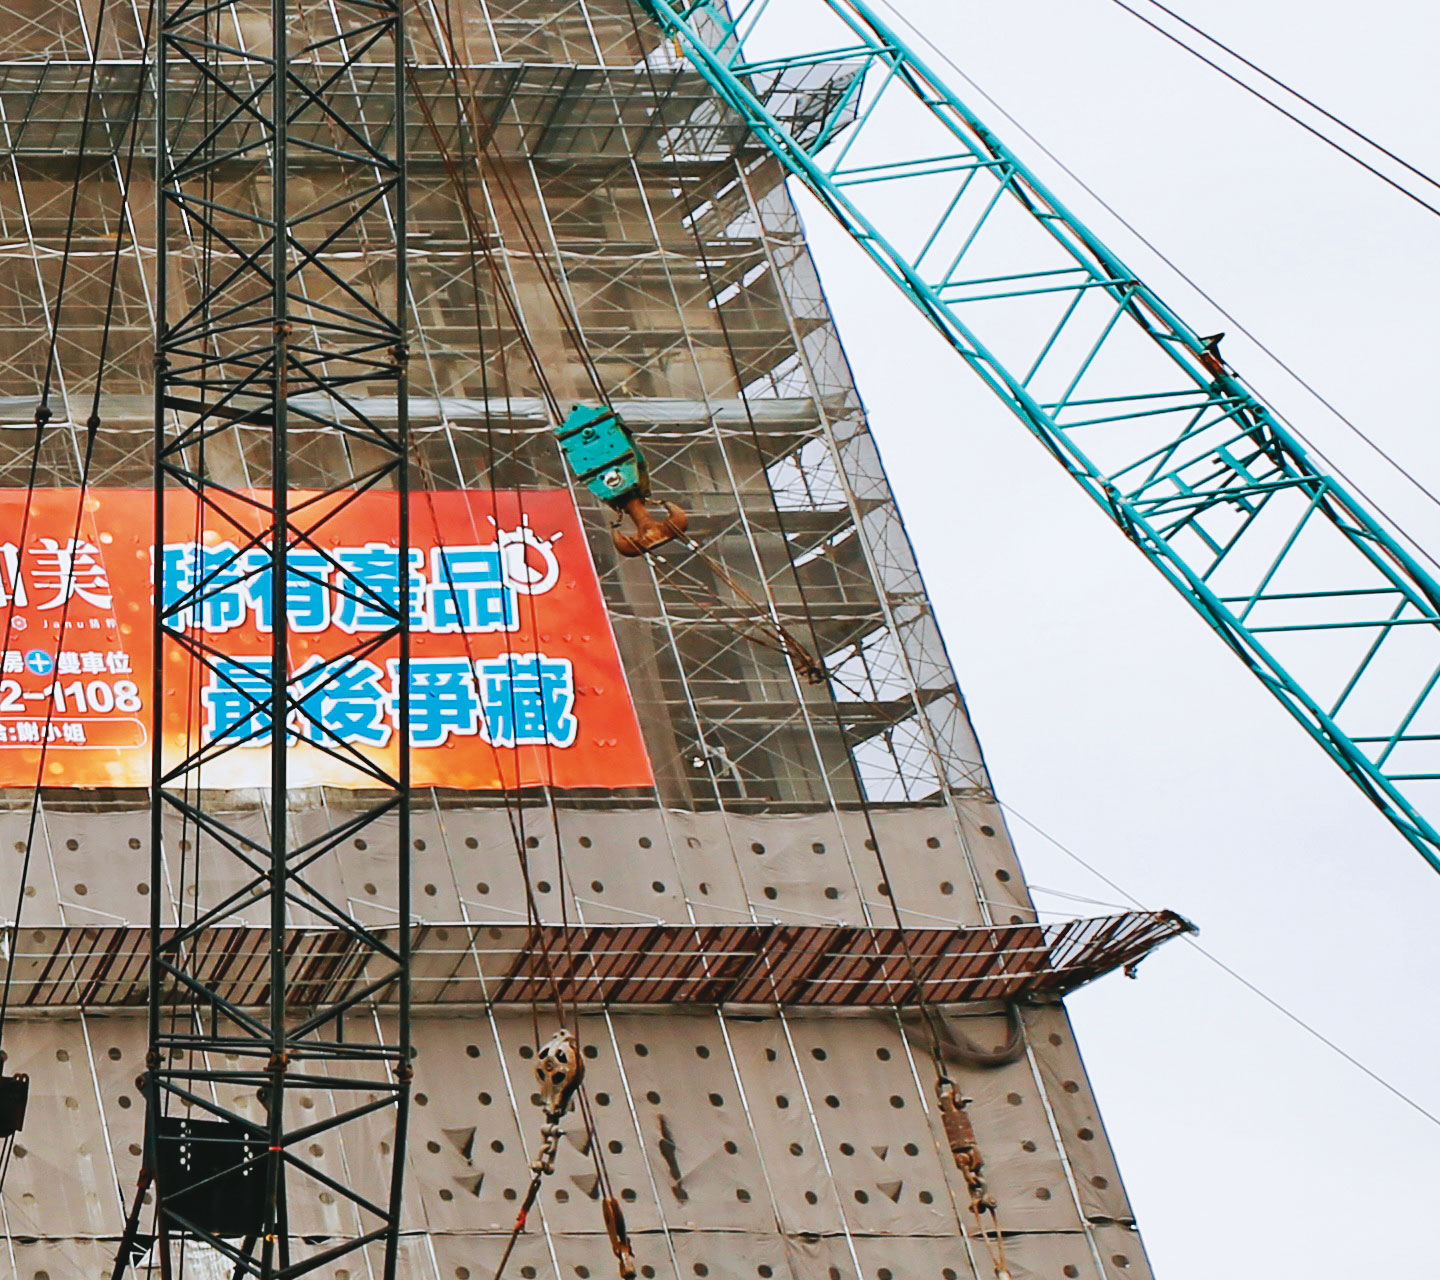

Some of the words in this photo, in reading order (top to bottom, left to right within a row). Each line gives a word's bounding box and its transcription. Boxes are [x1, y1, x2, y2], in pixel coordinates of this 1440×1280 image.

[150, 542, 520, 633] 稀有產品
[201, 653, 579, 749] 最後爭藏
